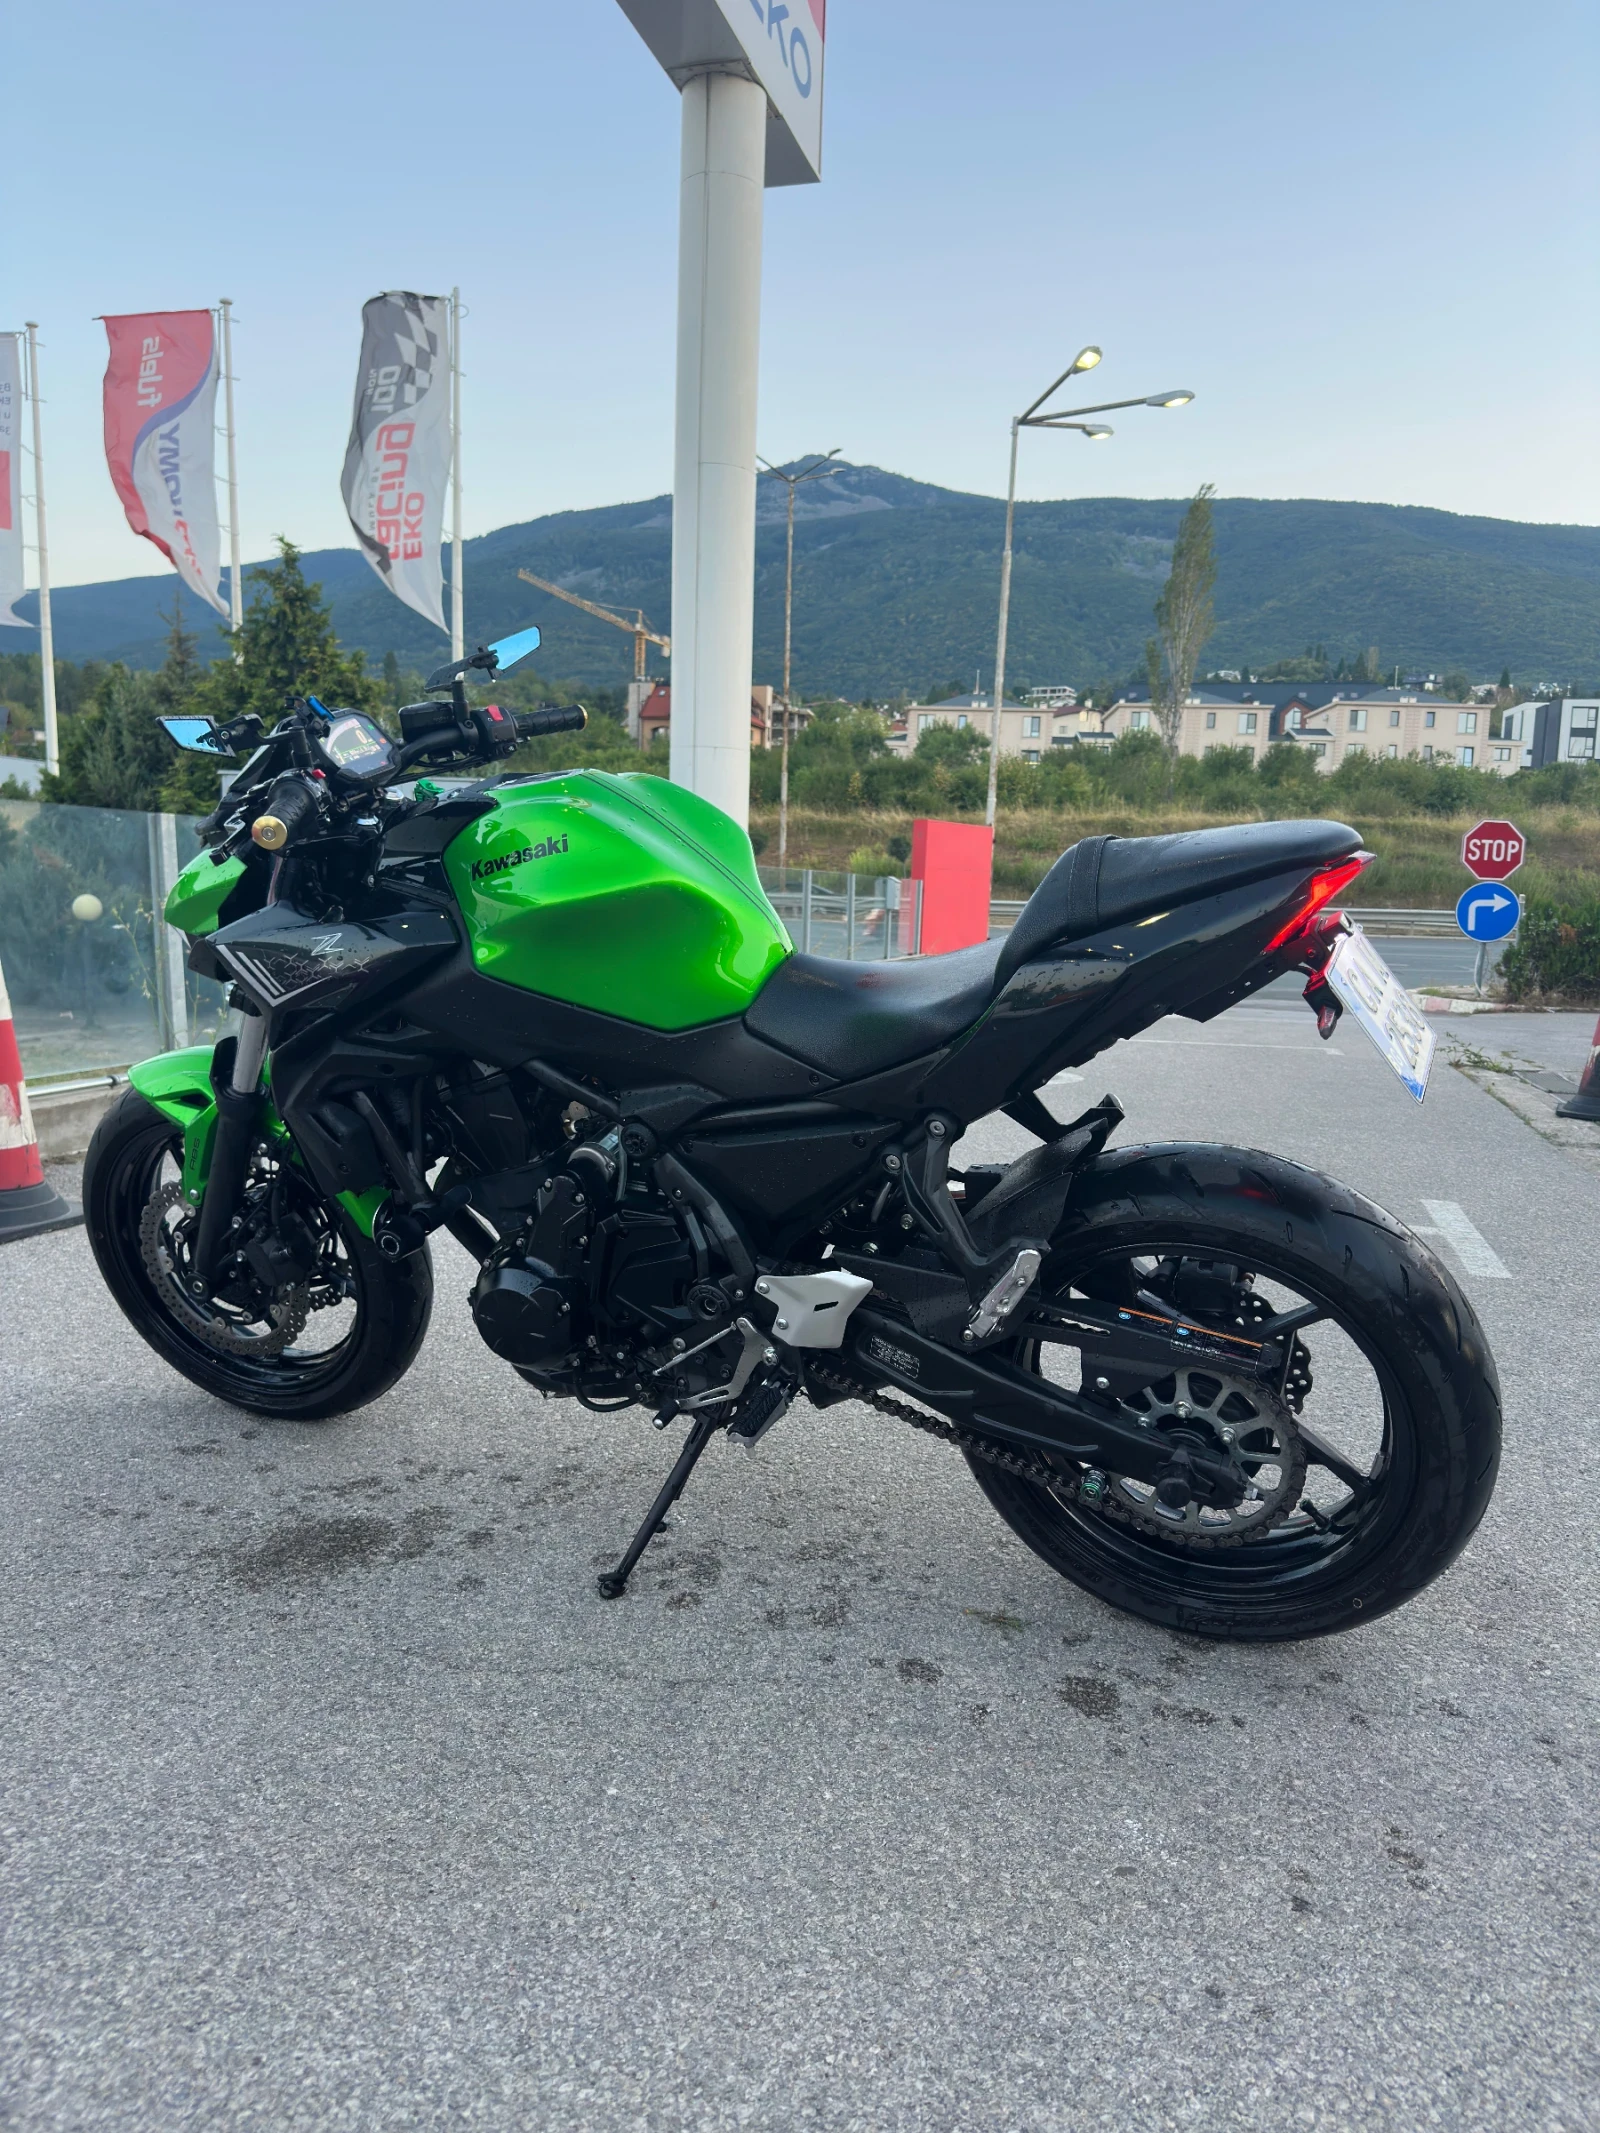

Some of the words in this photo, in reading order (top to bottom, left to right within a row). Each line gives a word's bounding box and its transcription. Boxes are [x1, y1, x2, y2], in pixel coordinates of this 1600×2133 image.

[749, 0, 812, 99] KO
[471, 833, 569, 881] Kawasaki
[1467, 839, 1520, 862] STOP
